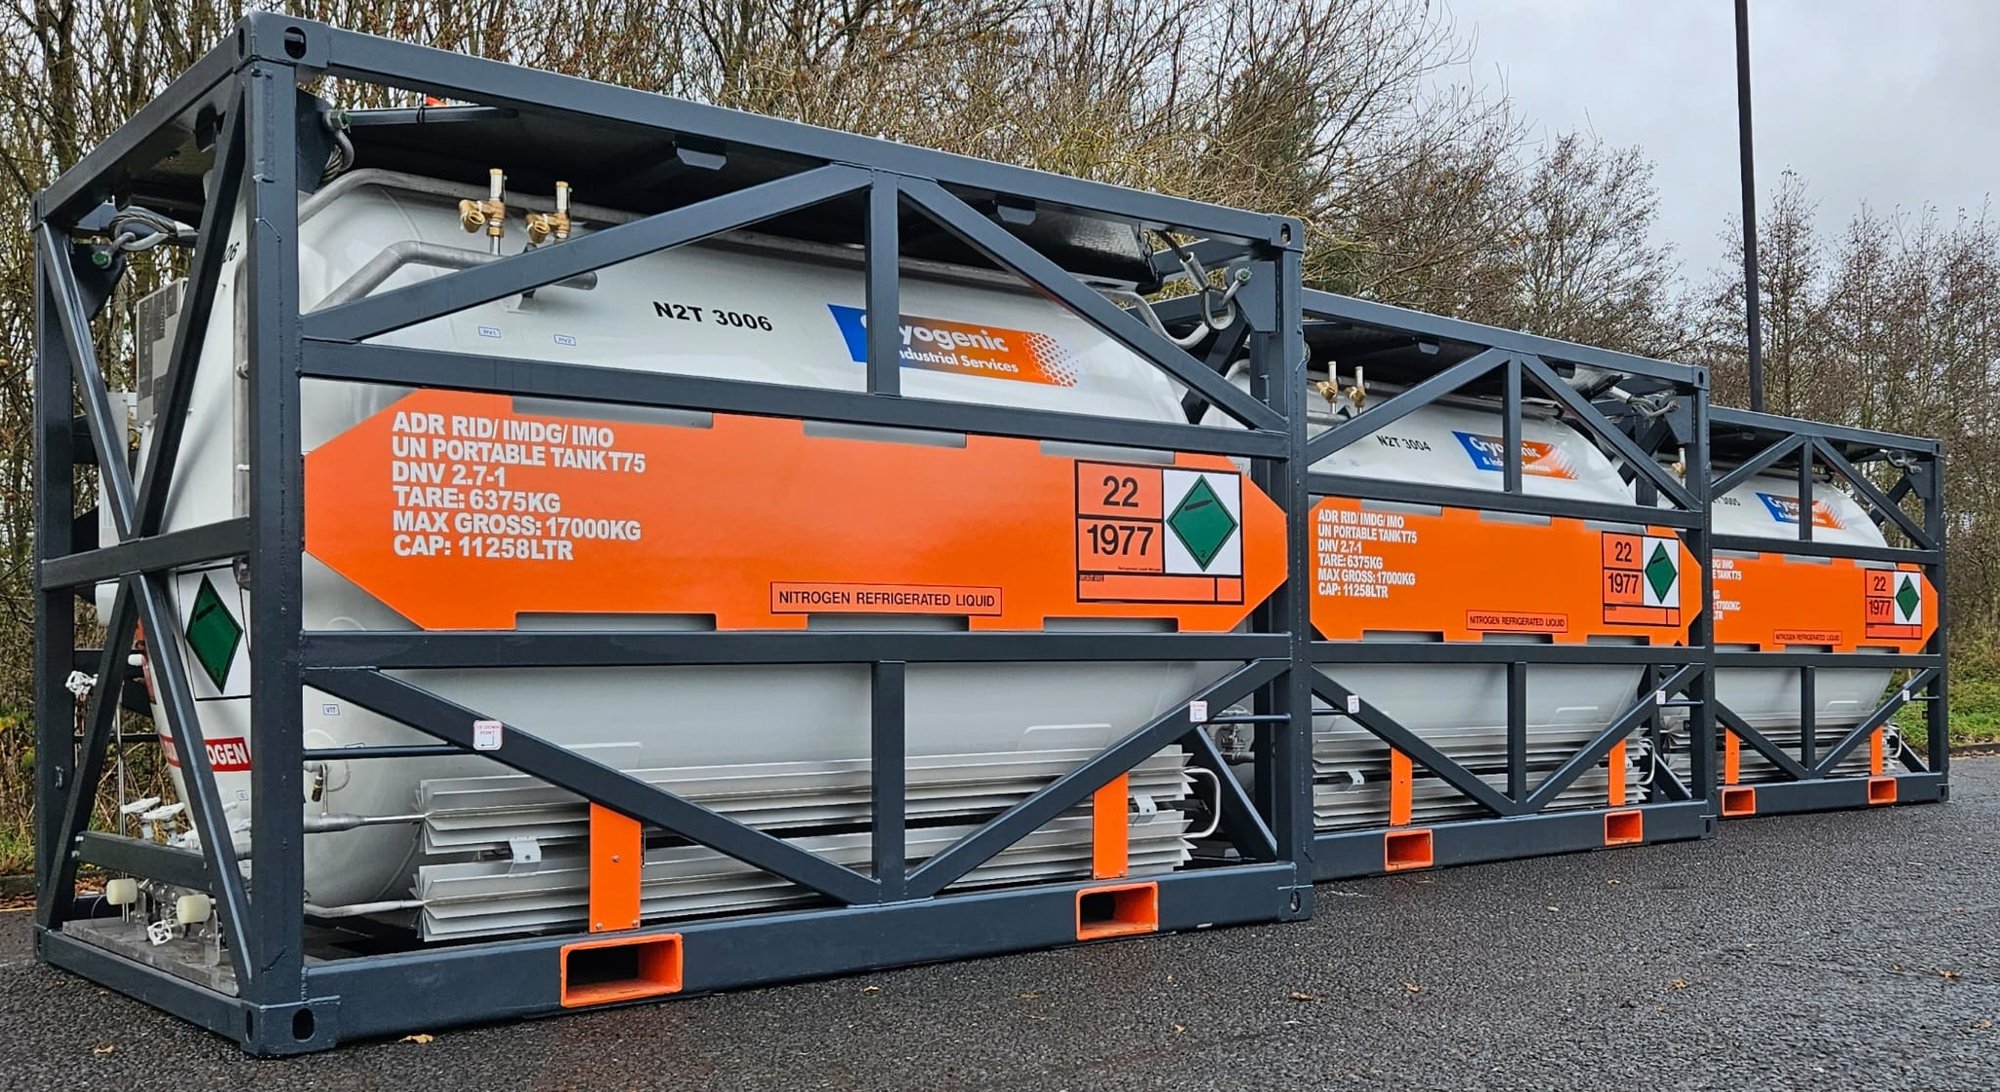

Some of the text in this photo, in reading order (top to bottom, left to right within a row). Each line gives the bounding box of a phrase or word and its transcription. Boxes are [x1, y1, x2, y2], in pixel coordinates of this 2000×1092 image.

[653, 301, 773, 332] N2T 3006
[860, 314, 1009, 352] yogenic
[899, 348, 1019, 373] ndustrial Services
[392, 411, 614, 448] ADR RID/ IMDG/ IMO
[1376, 435, 1431, 451] N2T 3004
[1469, 436, 1541, 458] Cryonic
[392, 436, 646, 473] UN PORTABLE TANK T75
[392, 461, 506, 487] DNV 2.7-1
[393, 485, 561, 513] TARE: 6375KG
[1103, 475, 1139, 508] 22
[393, 510, 642, 541] MAX GROSS: 17000KG
[1318, 509, 1404, 528] ADR RID/ IMDG/ IMO
[1086, 524, 1154, 556] 1977
[1318, 524, 1417, 544] UN PORTABLE TANK T75
[393, 534, 574, 561] CAP: 11258LTR
[1318, 538, 1362, 553] DNV 2.7-1
[1615, 541, 1632, 562] 22
[1318, 553, 1383, 569] TARE: 6375KG
[1318, 567, 1416, 585] MAX GROSS: 17000KG
[1607, 573, 1639, 594] 1977
[1874, 576, 1886, 592] 22
[779, 591, 996, 607] NITROGEN REFRIGERATED LIQUID
[1319, 582, 1388, 598] CAP: 11258LTR
[1868, 600, 1891, 615] 1977
[1470, 615, 1565, 627] NITROGEN REFRIGERATED LIQUID
[205, 743, 248, 765] OGEN
